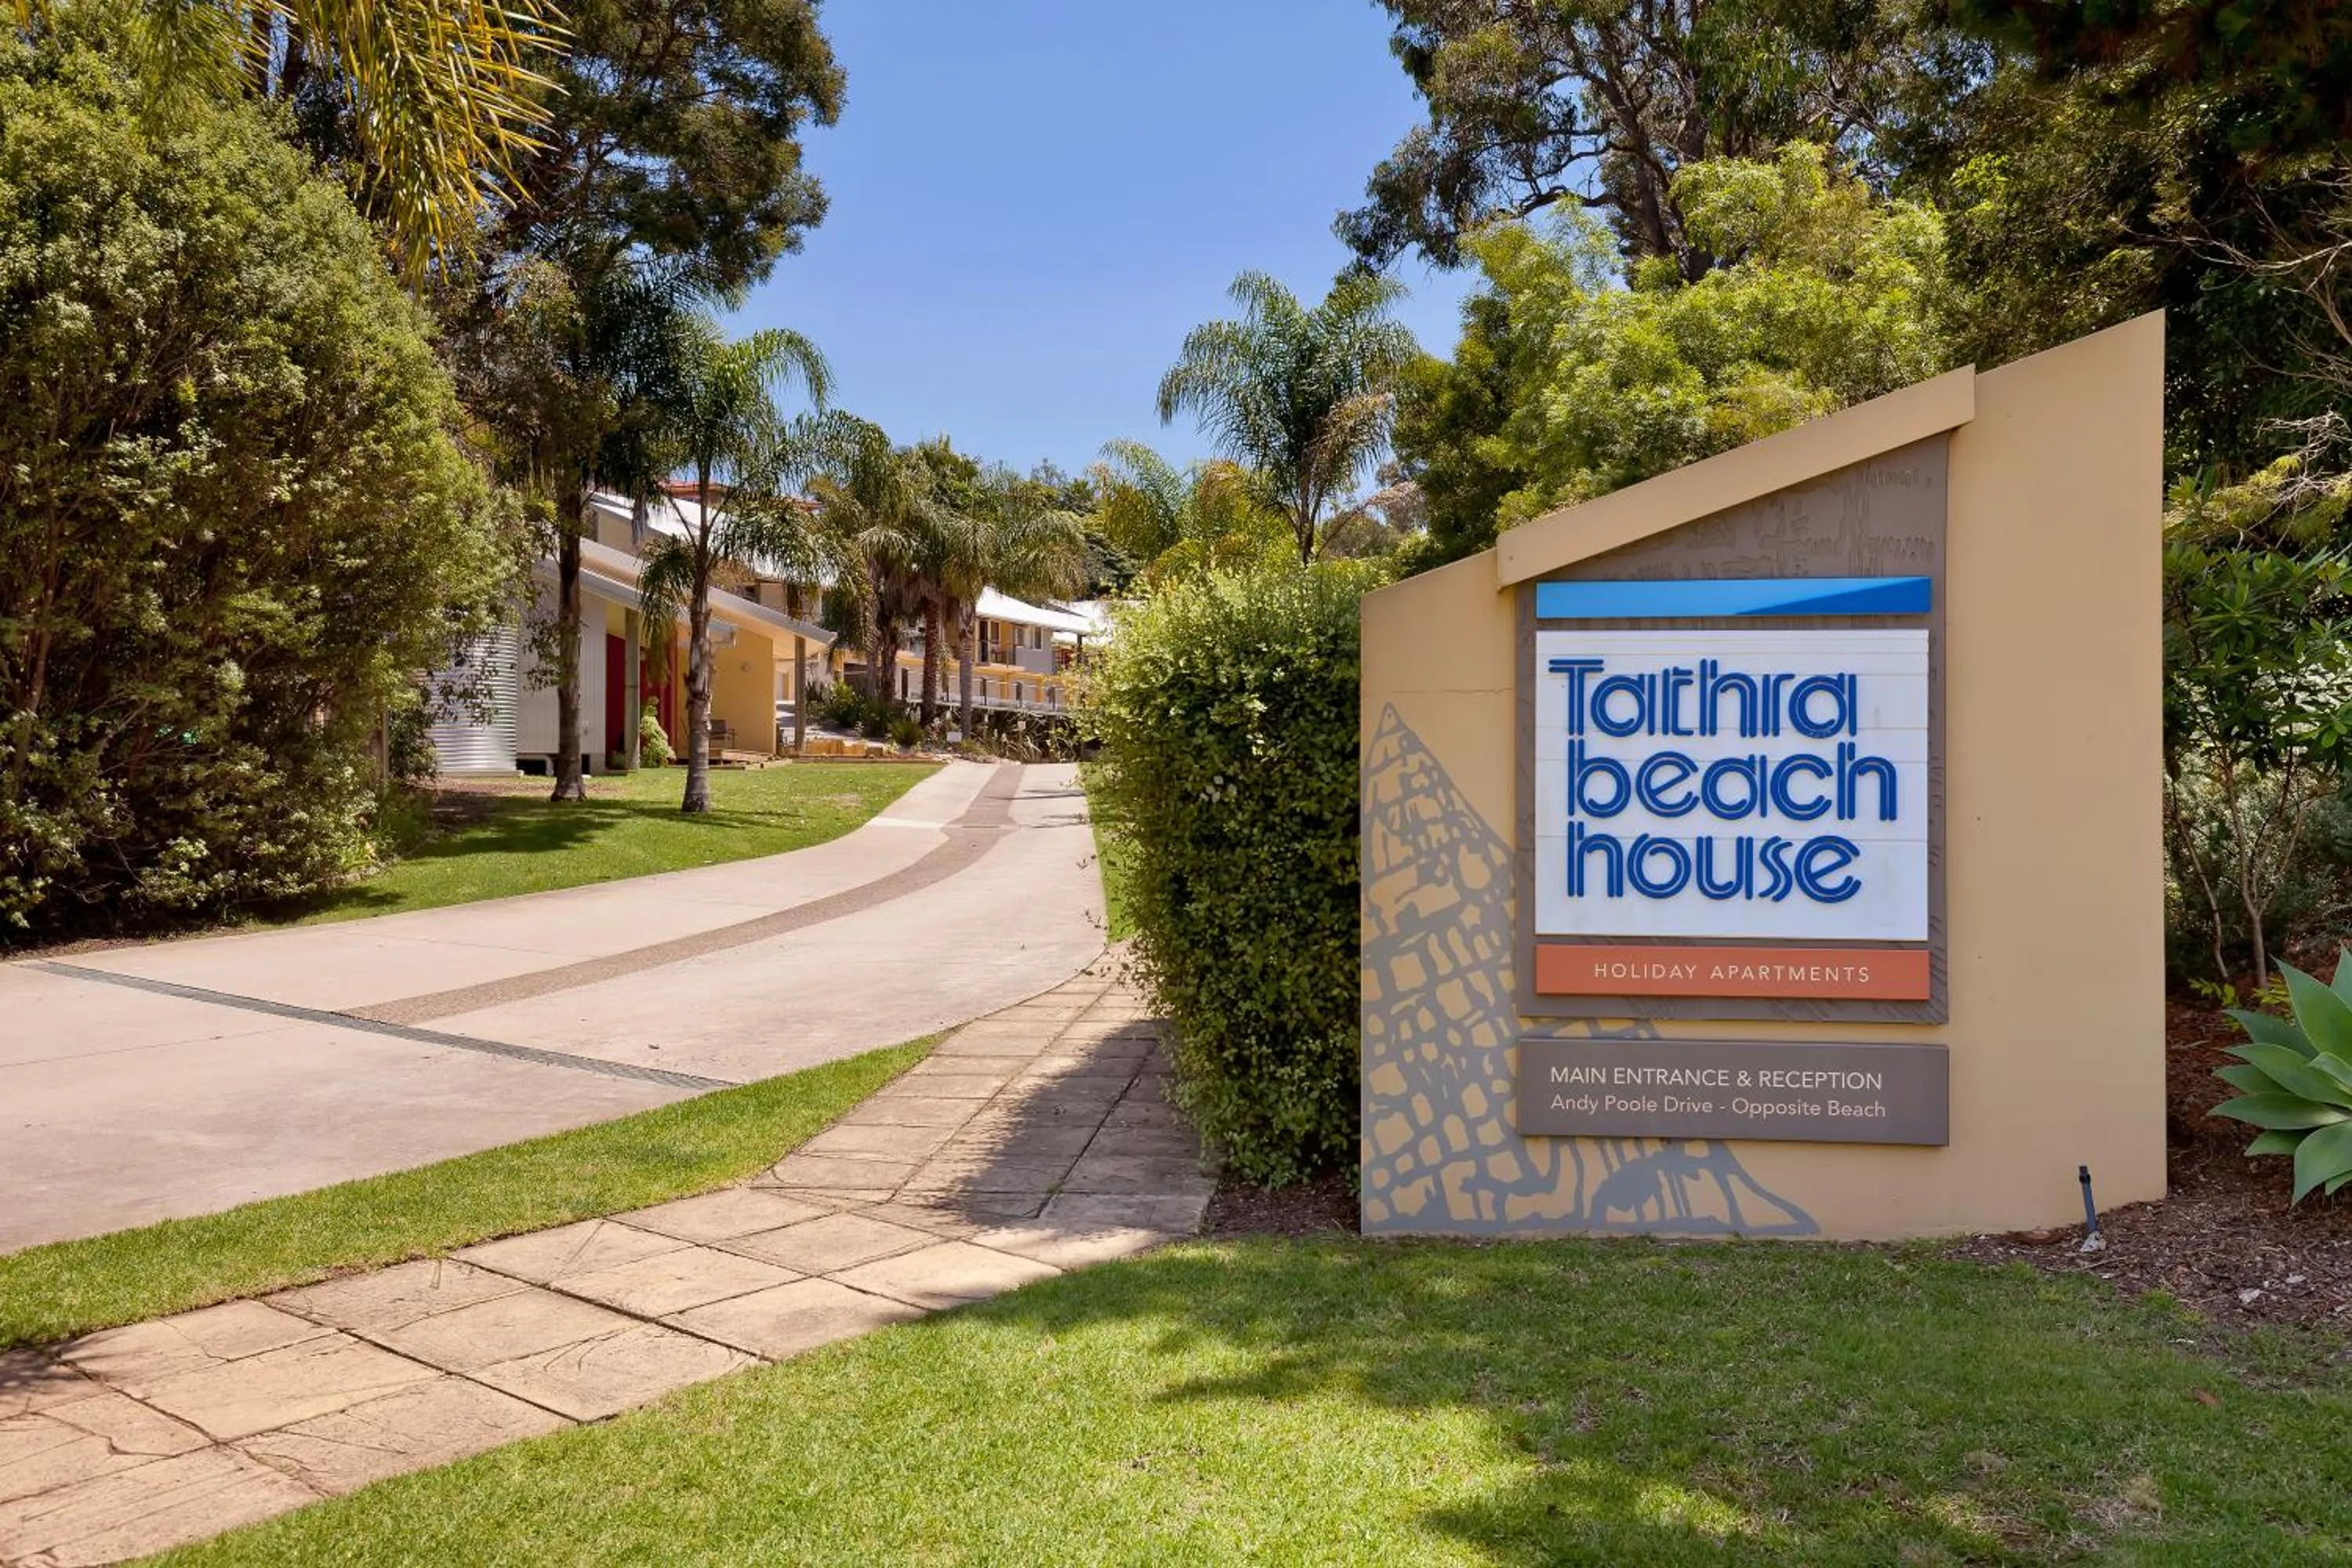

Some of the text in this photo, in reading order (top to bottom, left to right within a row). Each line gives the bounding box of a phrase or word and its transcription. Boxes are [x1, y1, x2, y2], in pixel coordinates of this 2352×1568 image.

[1548, 658, 1857, 739] Tathra
[1567, 739, 1897, 822] beach
[1567, 821, 1862, 904] house
[1595, 963, 1870, 982] HOLIDAY APARTMENTS
[1551, 1066, 1882, 1090] MAIN ENTRANCE & RECEPTION
[1550, 1094, 1599, 1115] Andy
[1605, 1095, 1657, 1112] Poole
[1664, 1096, 1712, 1112] Drive
[1732, 1098, 1821, 1119] Opposite
[1828, 1100, 1886, 1117] Beach
